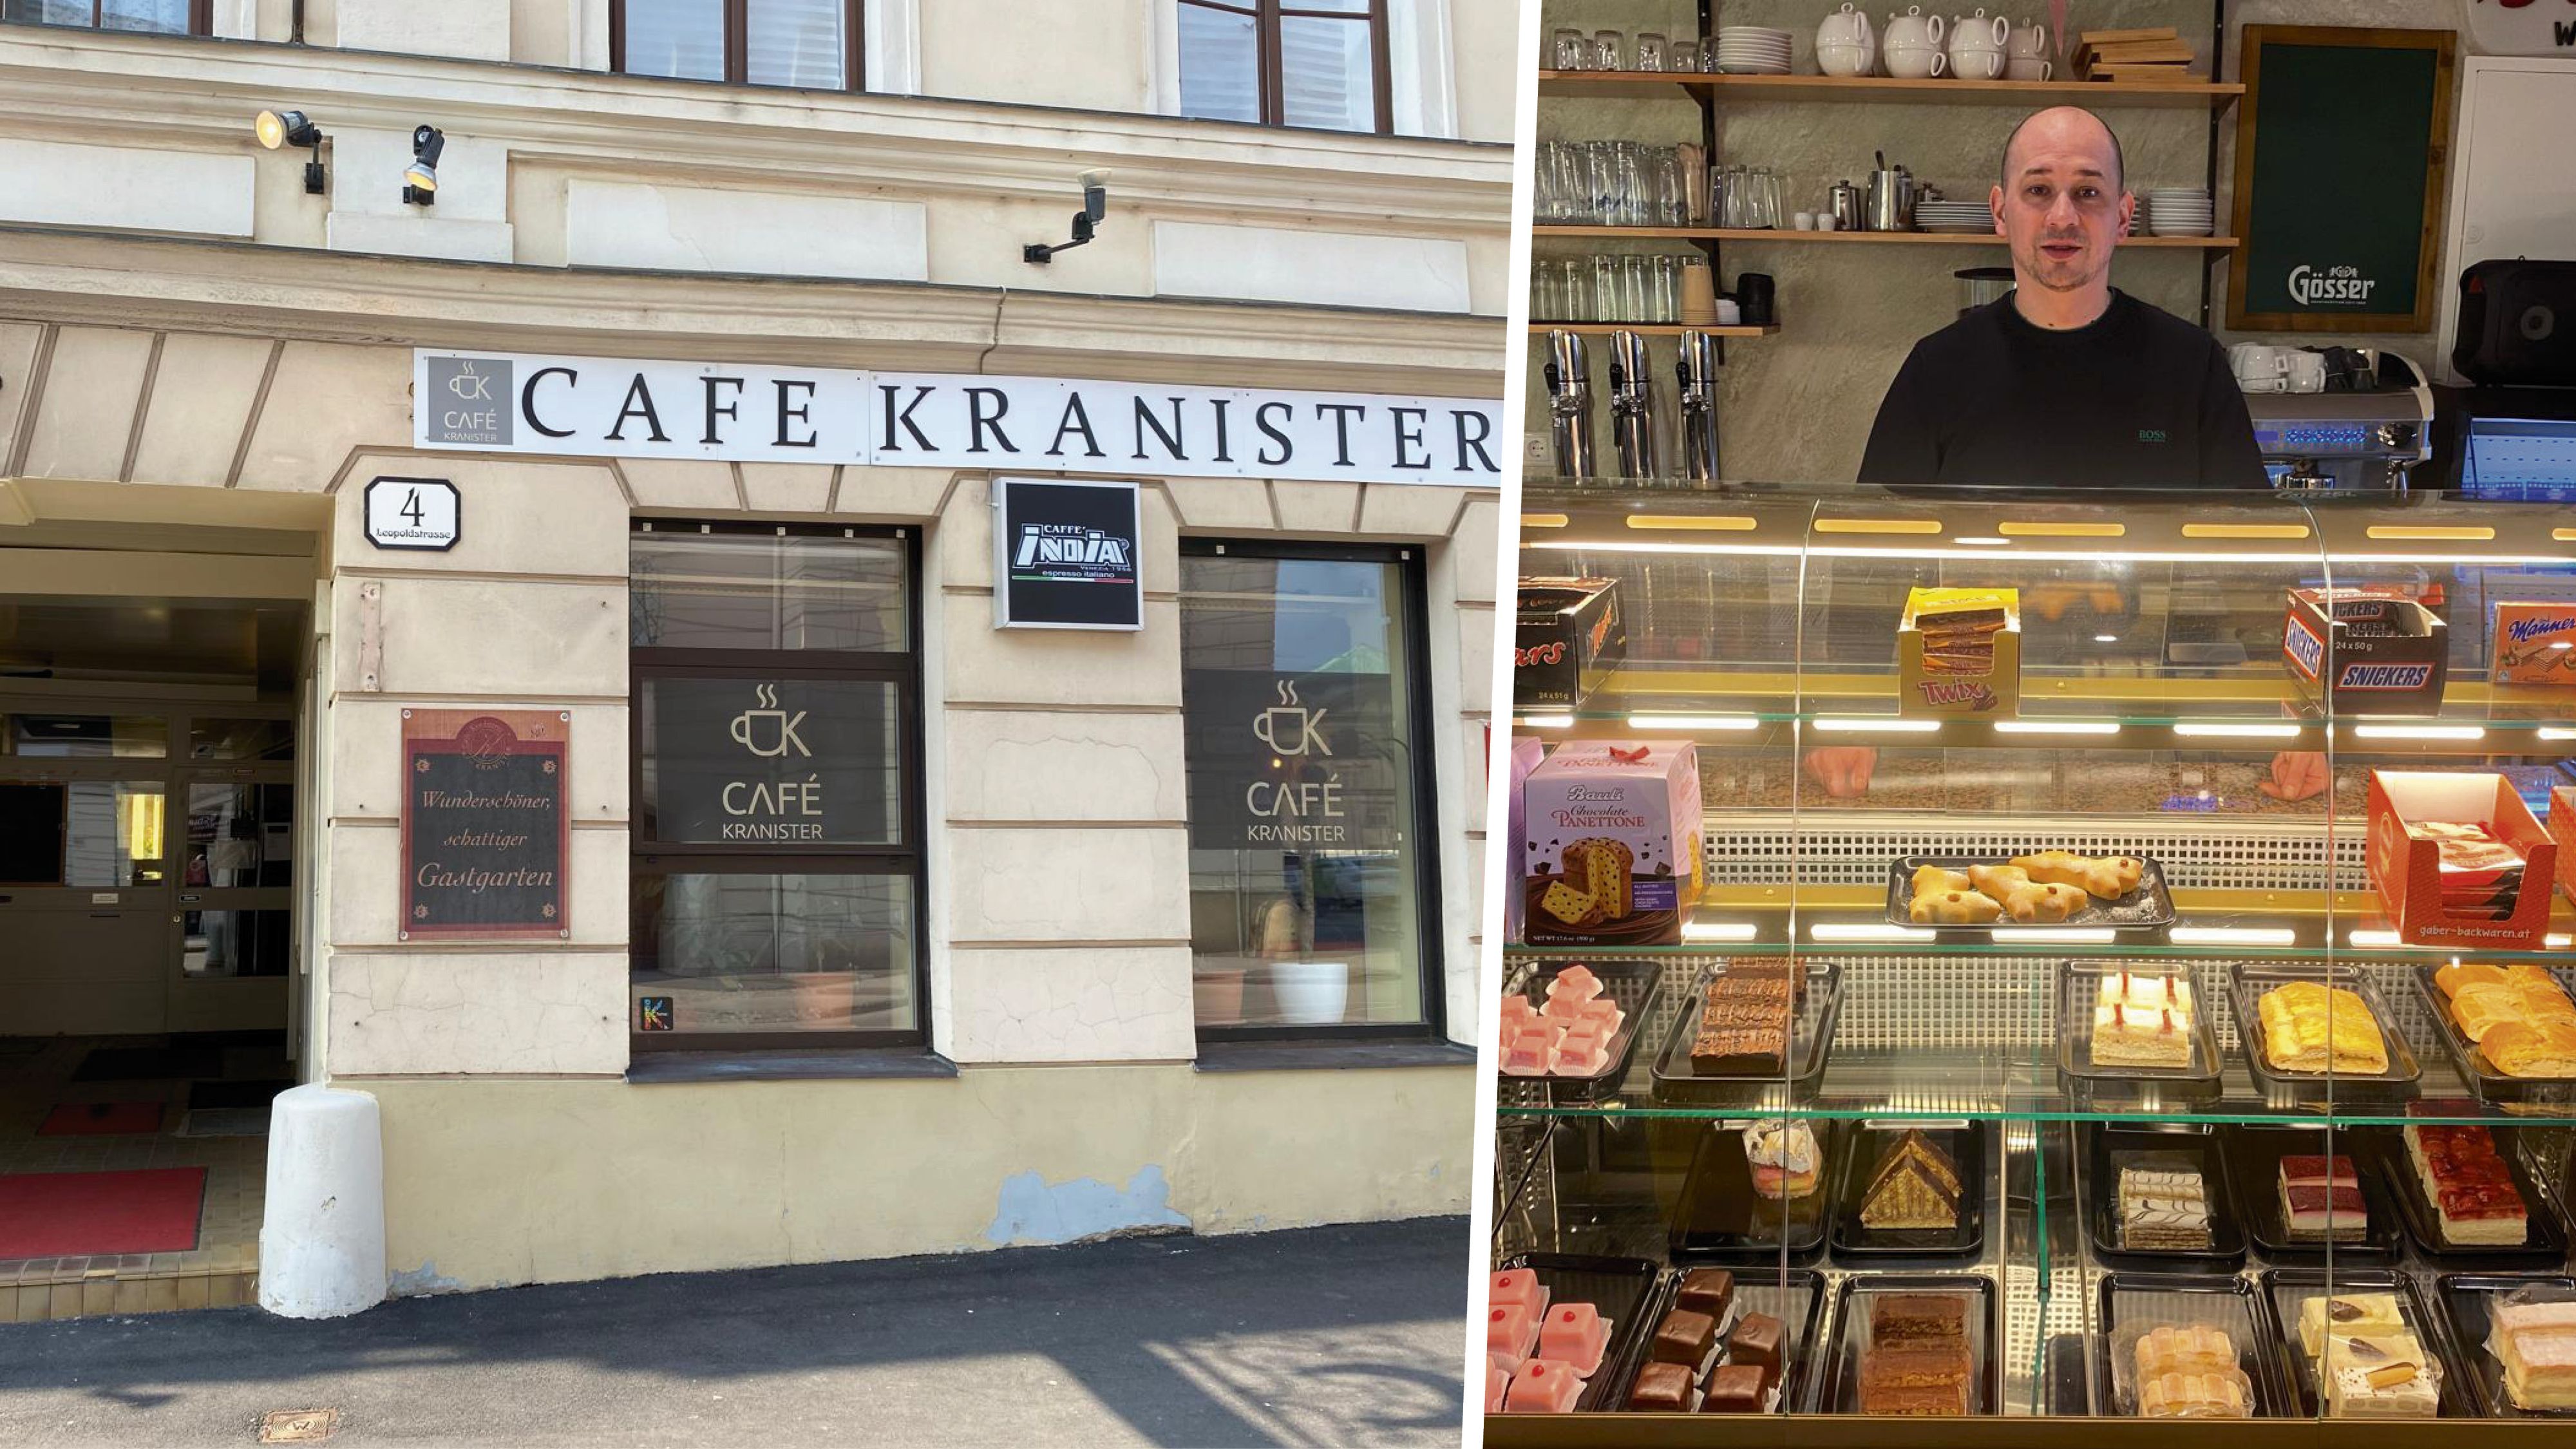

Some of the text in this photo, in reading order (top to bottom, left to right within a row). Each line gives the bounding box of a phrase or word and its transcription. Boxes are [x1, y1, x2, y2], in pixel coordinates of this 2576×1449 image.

[2288, 265, 2375, 305] Gösser
[444, 408, 497, 430] CAFÉ
[522, 367, 1501, 473] CAFE KRANISTER
[444, 432, 497, 442] KRANISTER
[400, 487, 425, 527] 4
[376, 527, 450, 540] Leopoldstrasse
[2285, 619, 2324, 676] SNICKERS
[2335, 641, 2346, 650] 24
[2367, 643, 2372, 652] g
[2343, 666, 2428, 686] SNICKERS
[723, 773, 823, 816] CAFÉ
[1247, 774, 1345, 817] CAFÉ
[1567, 784, 1625, 802] Bauli
[1551, 810, 1645, 828] PANETTONE
[1571, 805, 1629, 816] Chocolate
[443, 829, 527, 851] schattiger
[723, 823, 823, 839] KRANISTER
[1247, 825, 1345, 842] KRANISTER
[417, 862, 553, 894] Gastgarten
[2420, 926, 2530, 938] gaber-backwaren.at
